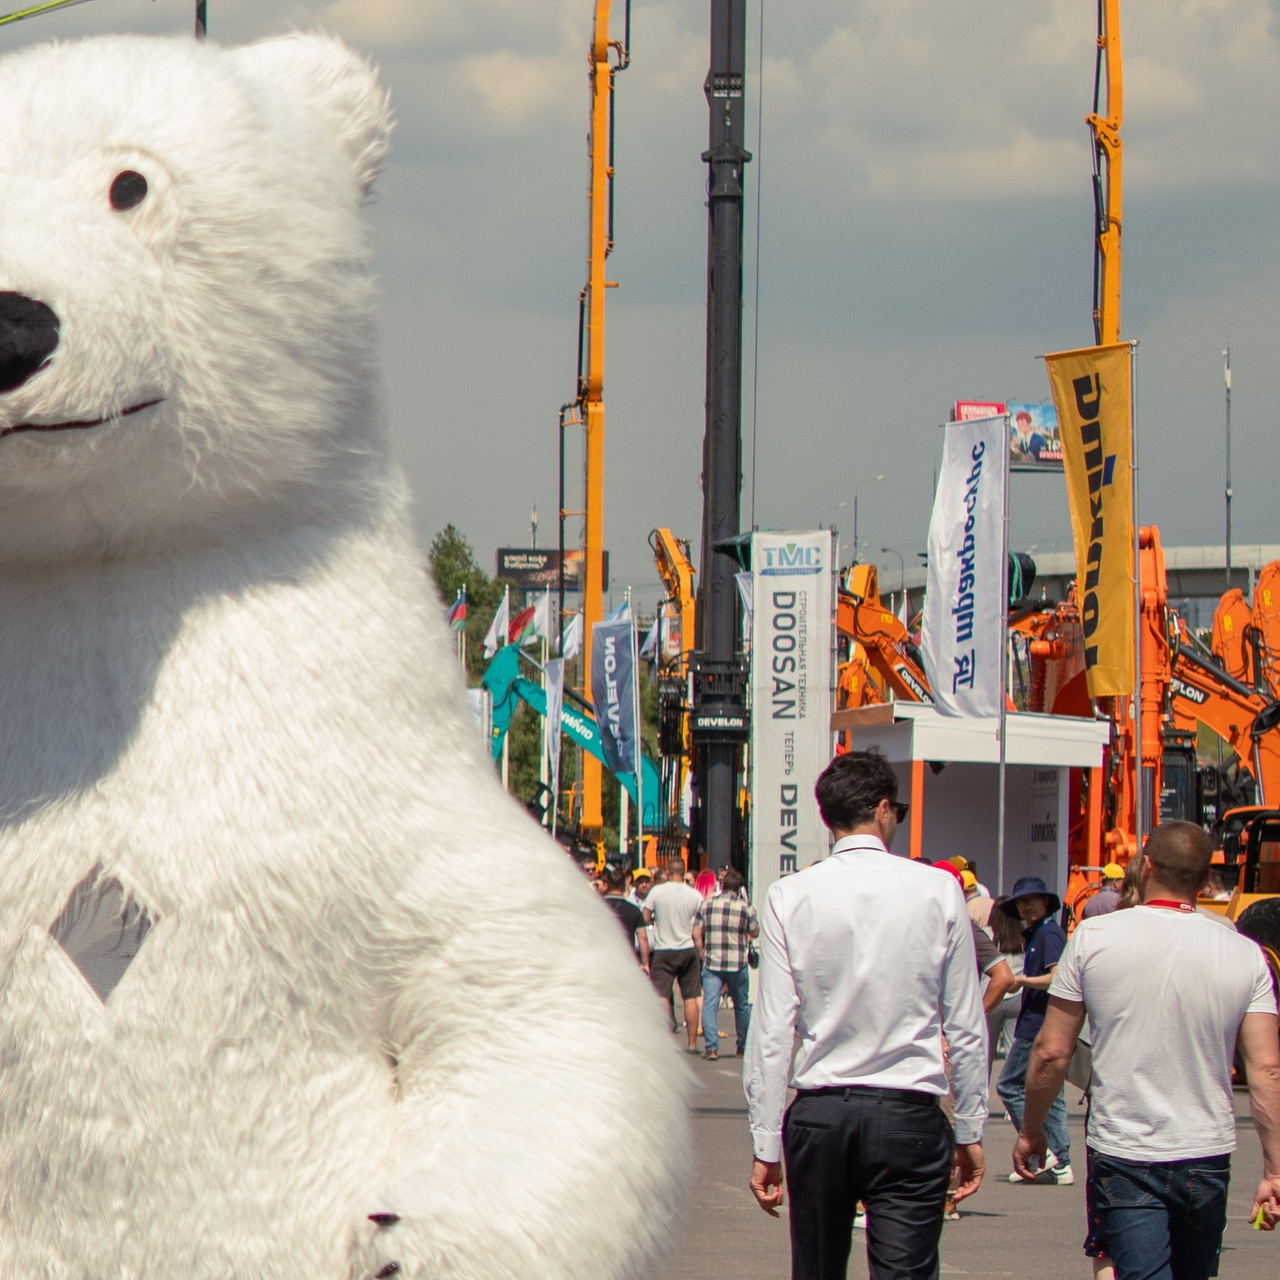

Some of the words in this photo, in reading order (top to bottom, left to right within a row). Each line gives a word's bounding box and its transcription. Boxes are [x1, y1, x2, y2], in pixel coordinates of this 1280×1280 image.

[772, 591, 796, 720] DOOSAN
[798, 590, 807, 670] СТРОИТЕЛЬНАЯ
[697, 717, 743, 728] DEVELON
[798, 672, 807, 719] ТЕХНИКА
[784, 730, 794, 776] ТЕПЕРЬ
[780, 784, 798, 878] DEVE
